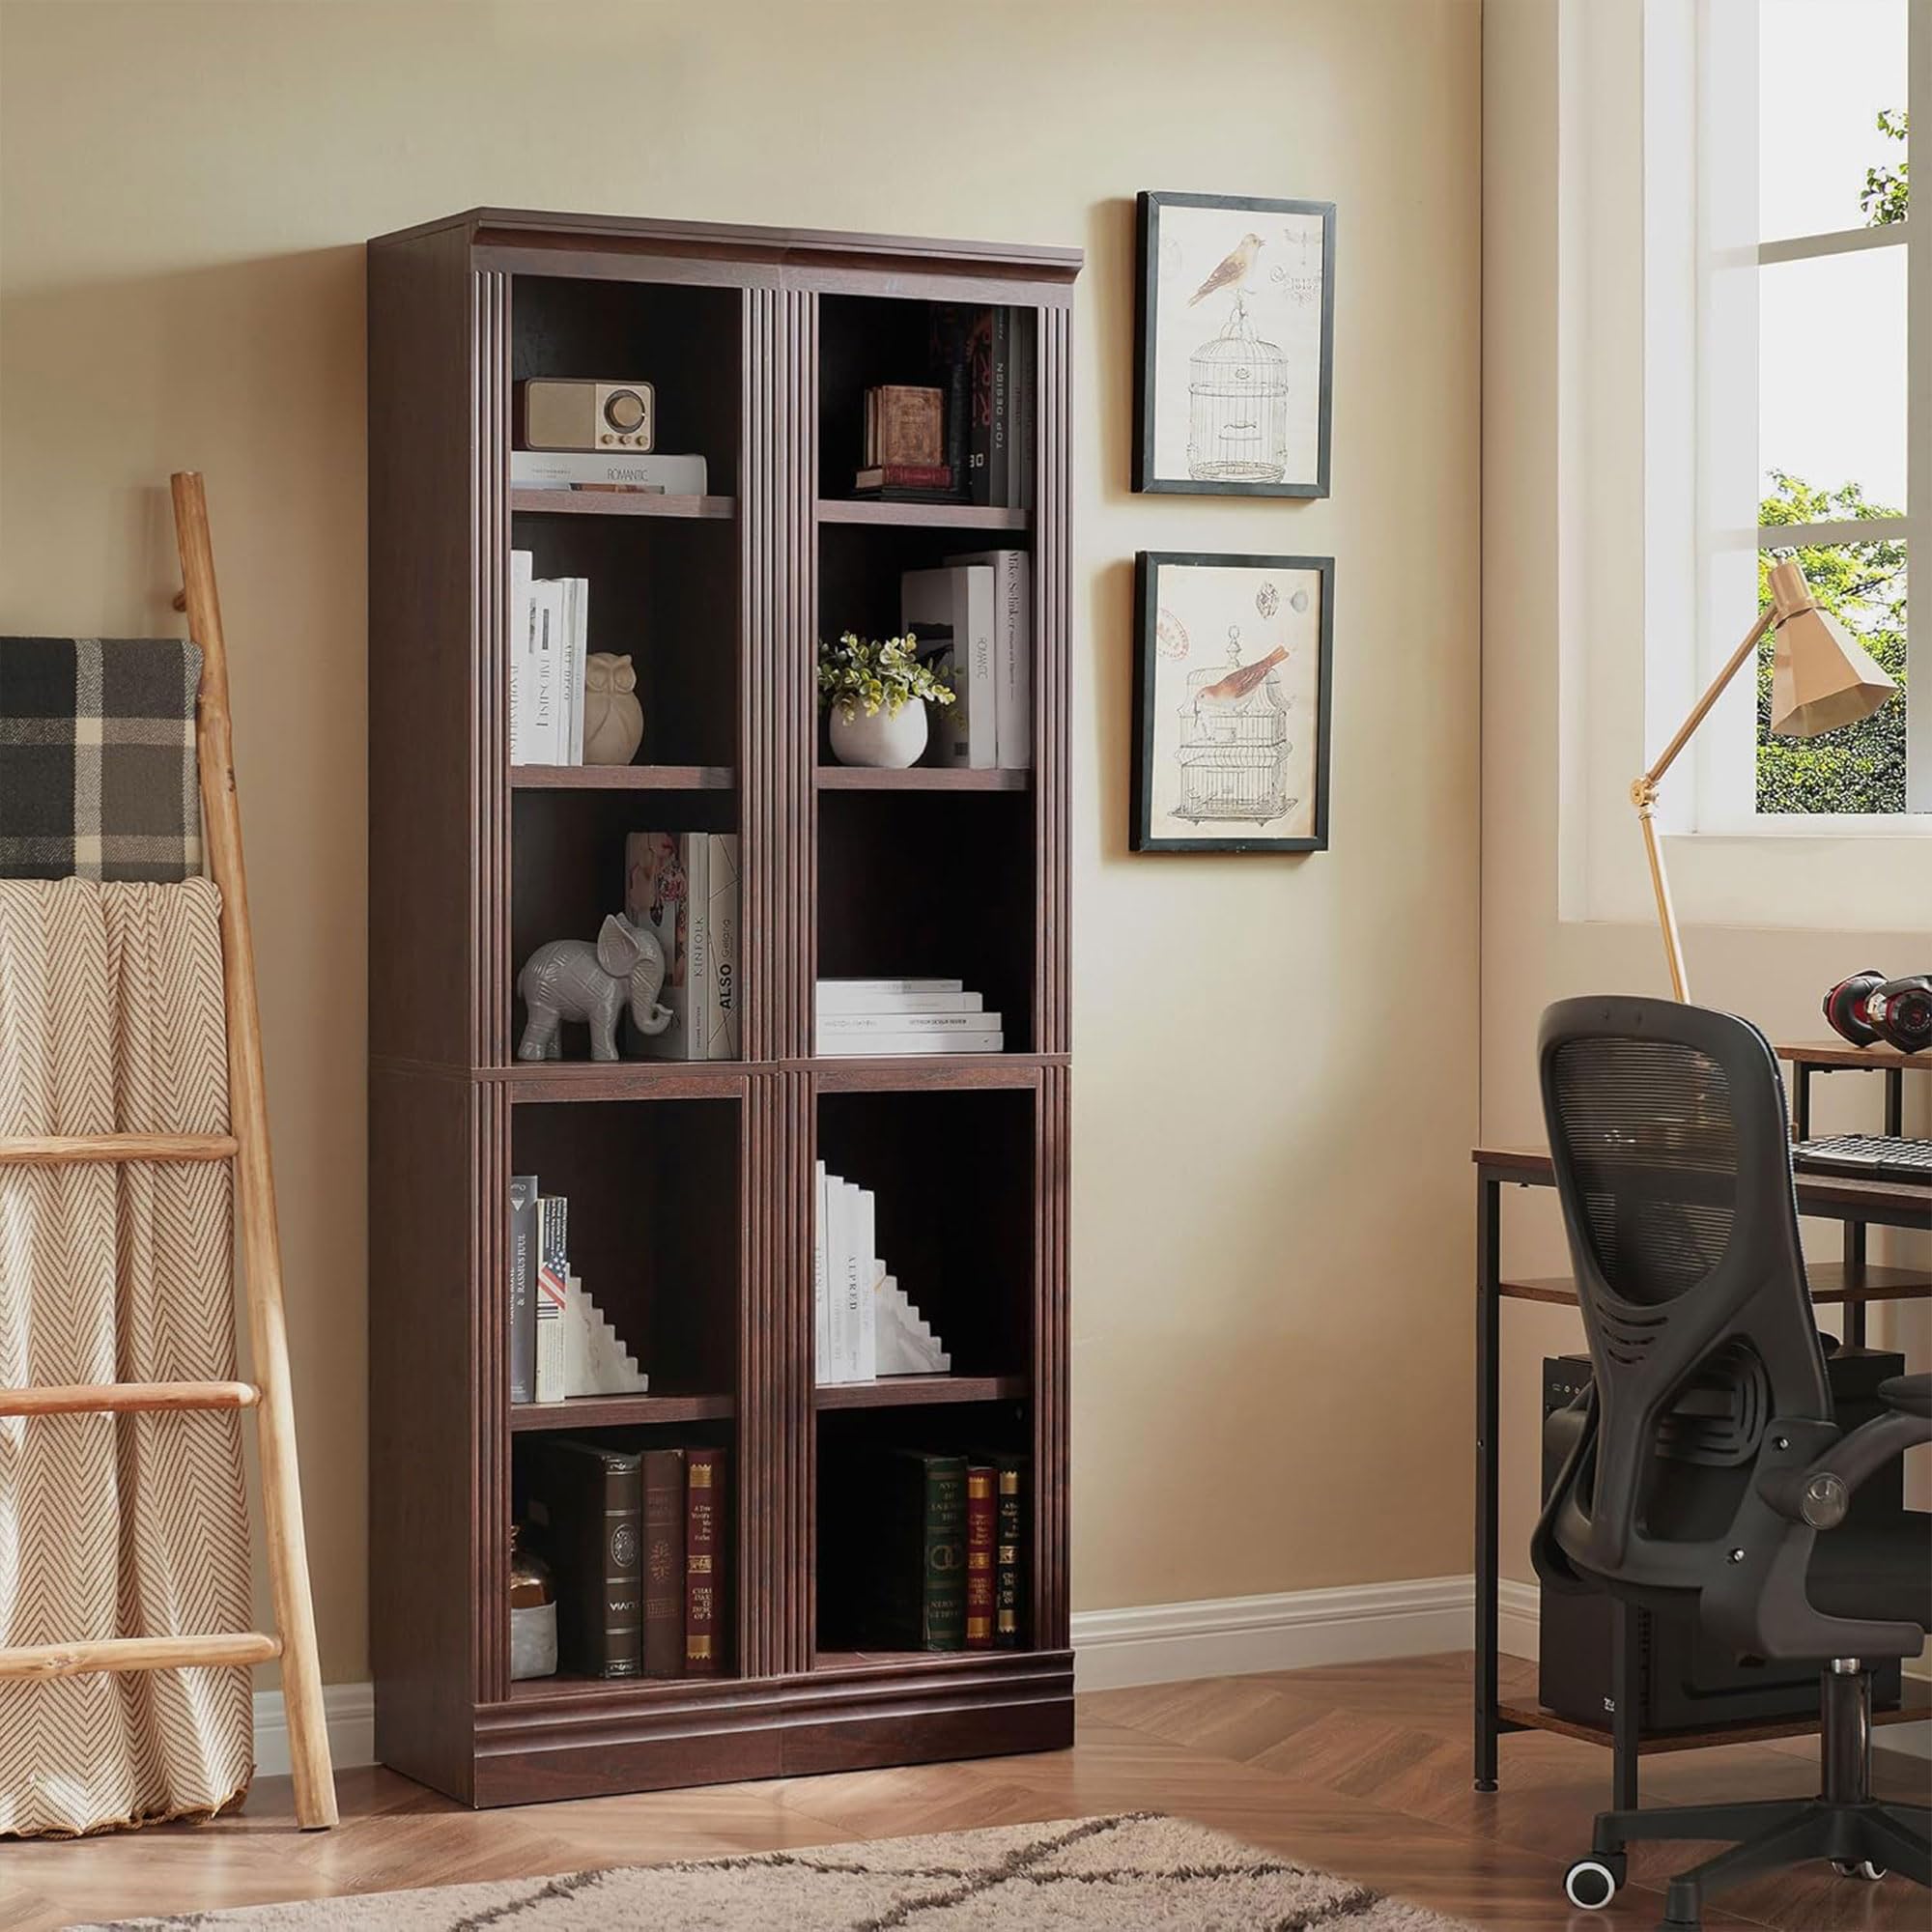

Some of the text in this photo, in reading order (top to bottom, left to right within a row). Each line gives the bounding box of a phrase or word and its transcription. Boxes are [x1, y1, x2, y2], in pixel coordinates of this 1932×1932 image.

[607, 469, 649, 482] ROMANTIC
[977, 636, 988, 680] ROMANTIC
[563, 669, 572, 700] DECO
[695, 916, 704, 979] KINFOLK
[720, 963, 732, 1010] ALSO
[517, 1257, 526, 1293] RASMUS
